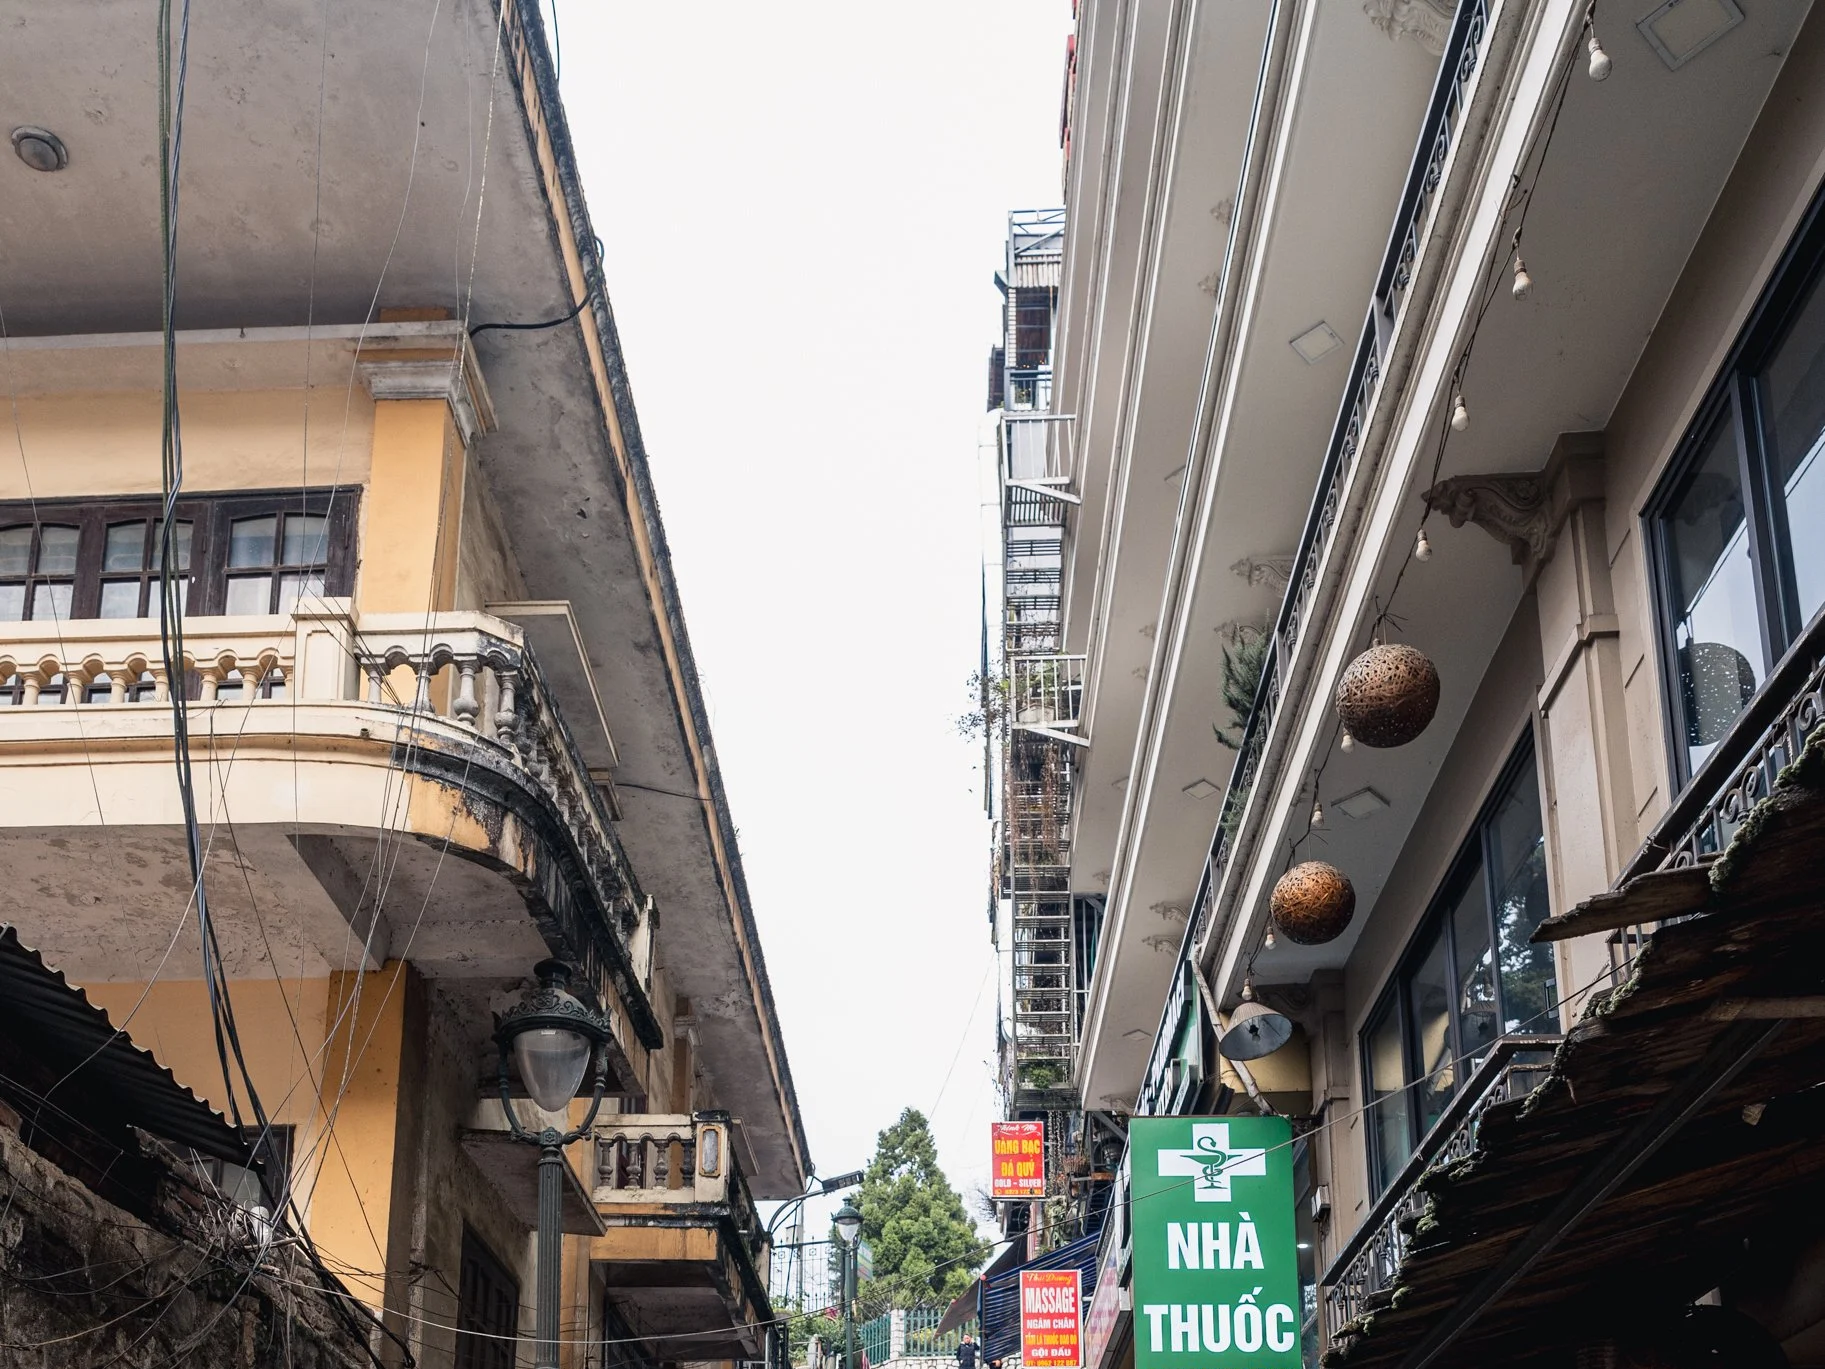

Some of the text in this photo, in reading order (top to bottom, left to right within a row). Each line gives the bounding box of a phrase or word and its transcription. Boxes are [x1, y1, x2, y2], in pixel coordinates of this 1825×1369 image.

[994, 1179, 1012, 1187] GOLD
[1018, 1178, 1042, 1187] SILVER
[1167, 1211, 1264, 1270] NHÀ
[1025, 1286, 1076, 1314] MASSAGE
[1026, 1316, 1075, 1329] NGÂM CHÂN
[1143, 1287, 1295, 1352] THUỐC
